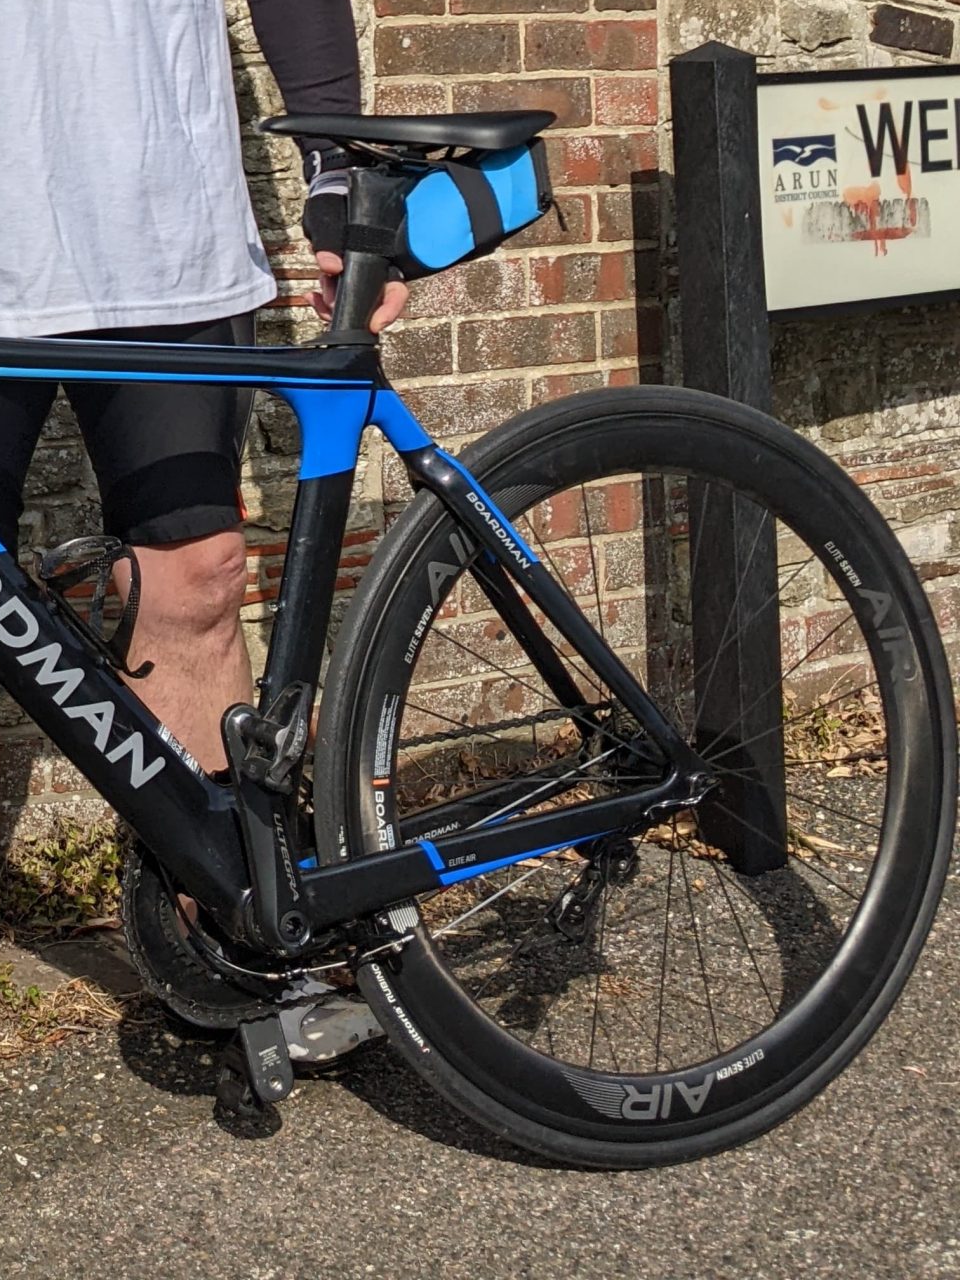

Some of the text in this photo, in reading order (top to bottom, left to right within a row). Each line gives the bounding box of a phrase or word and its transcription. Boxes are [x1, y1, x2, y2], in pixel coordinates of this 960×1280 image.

[774, 169, 838, 192] ARUN
[465, 491, 531, 570] BOARDMAN
[824, 540, 844, 562] ELITE
[839, 560, 862, 588] SEVEN
[404, 526, 475, 664] ELITE SEVEN AI
[273, 812, 300, 902] ULTEGRA
[448, 853, 476, 867] ELITE AIR
[621, 1048, 765, 1121] ELITE SEVEN AIR
